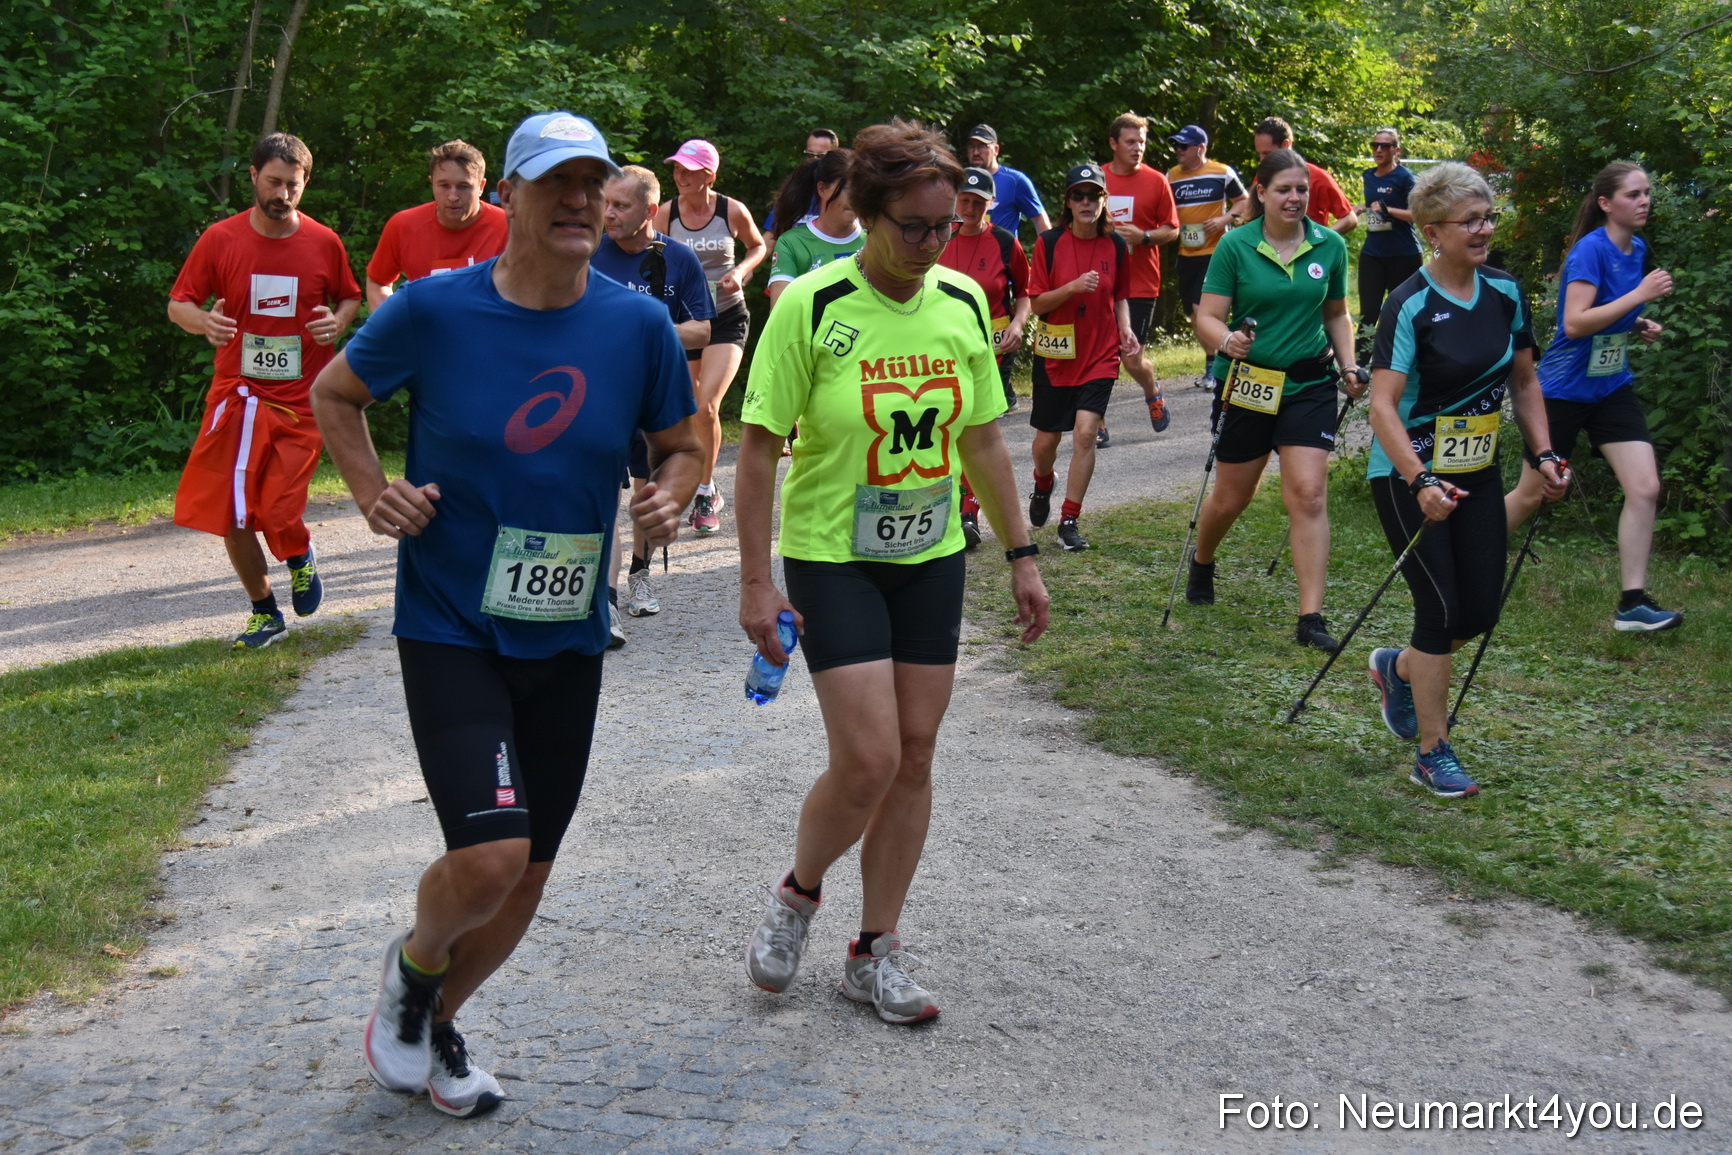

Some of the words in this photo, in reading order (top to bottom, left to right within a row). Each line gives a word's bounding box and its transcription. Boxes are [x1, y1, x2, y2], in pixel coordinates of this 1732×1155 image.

[1180, 187, 1213, 197] Fischer
[1184, 232, 1198, 241] 748
[1038, 333, 1069, 349] 2344
[253, 352, 288, 368] 496
[1599, 348, 1620, 365] 573
[859, 354, 956, 382] Müller
[1231, 377, 1275, 401] 2085
[889, 408, 939, 454] M
[1442, 434, 1492, 457] 2178
[876, 509, 933, 541] 675
[513, 545, 560, 560] firmenlauf
[884, 540, 912, 549] Sichert
[506, 562, 587, 597] 1886
[496, 601, 516, 610] Praxis
[508, 594, 544, 606] Mederer
[547, 597, 575, 606] Thomas
